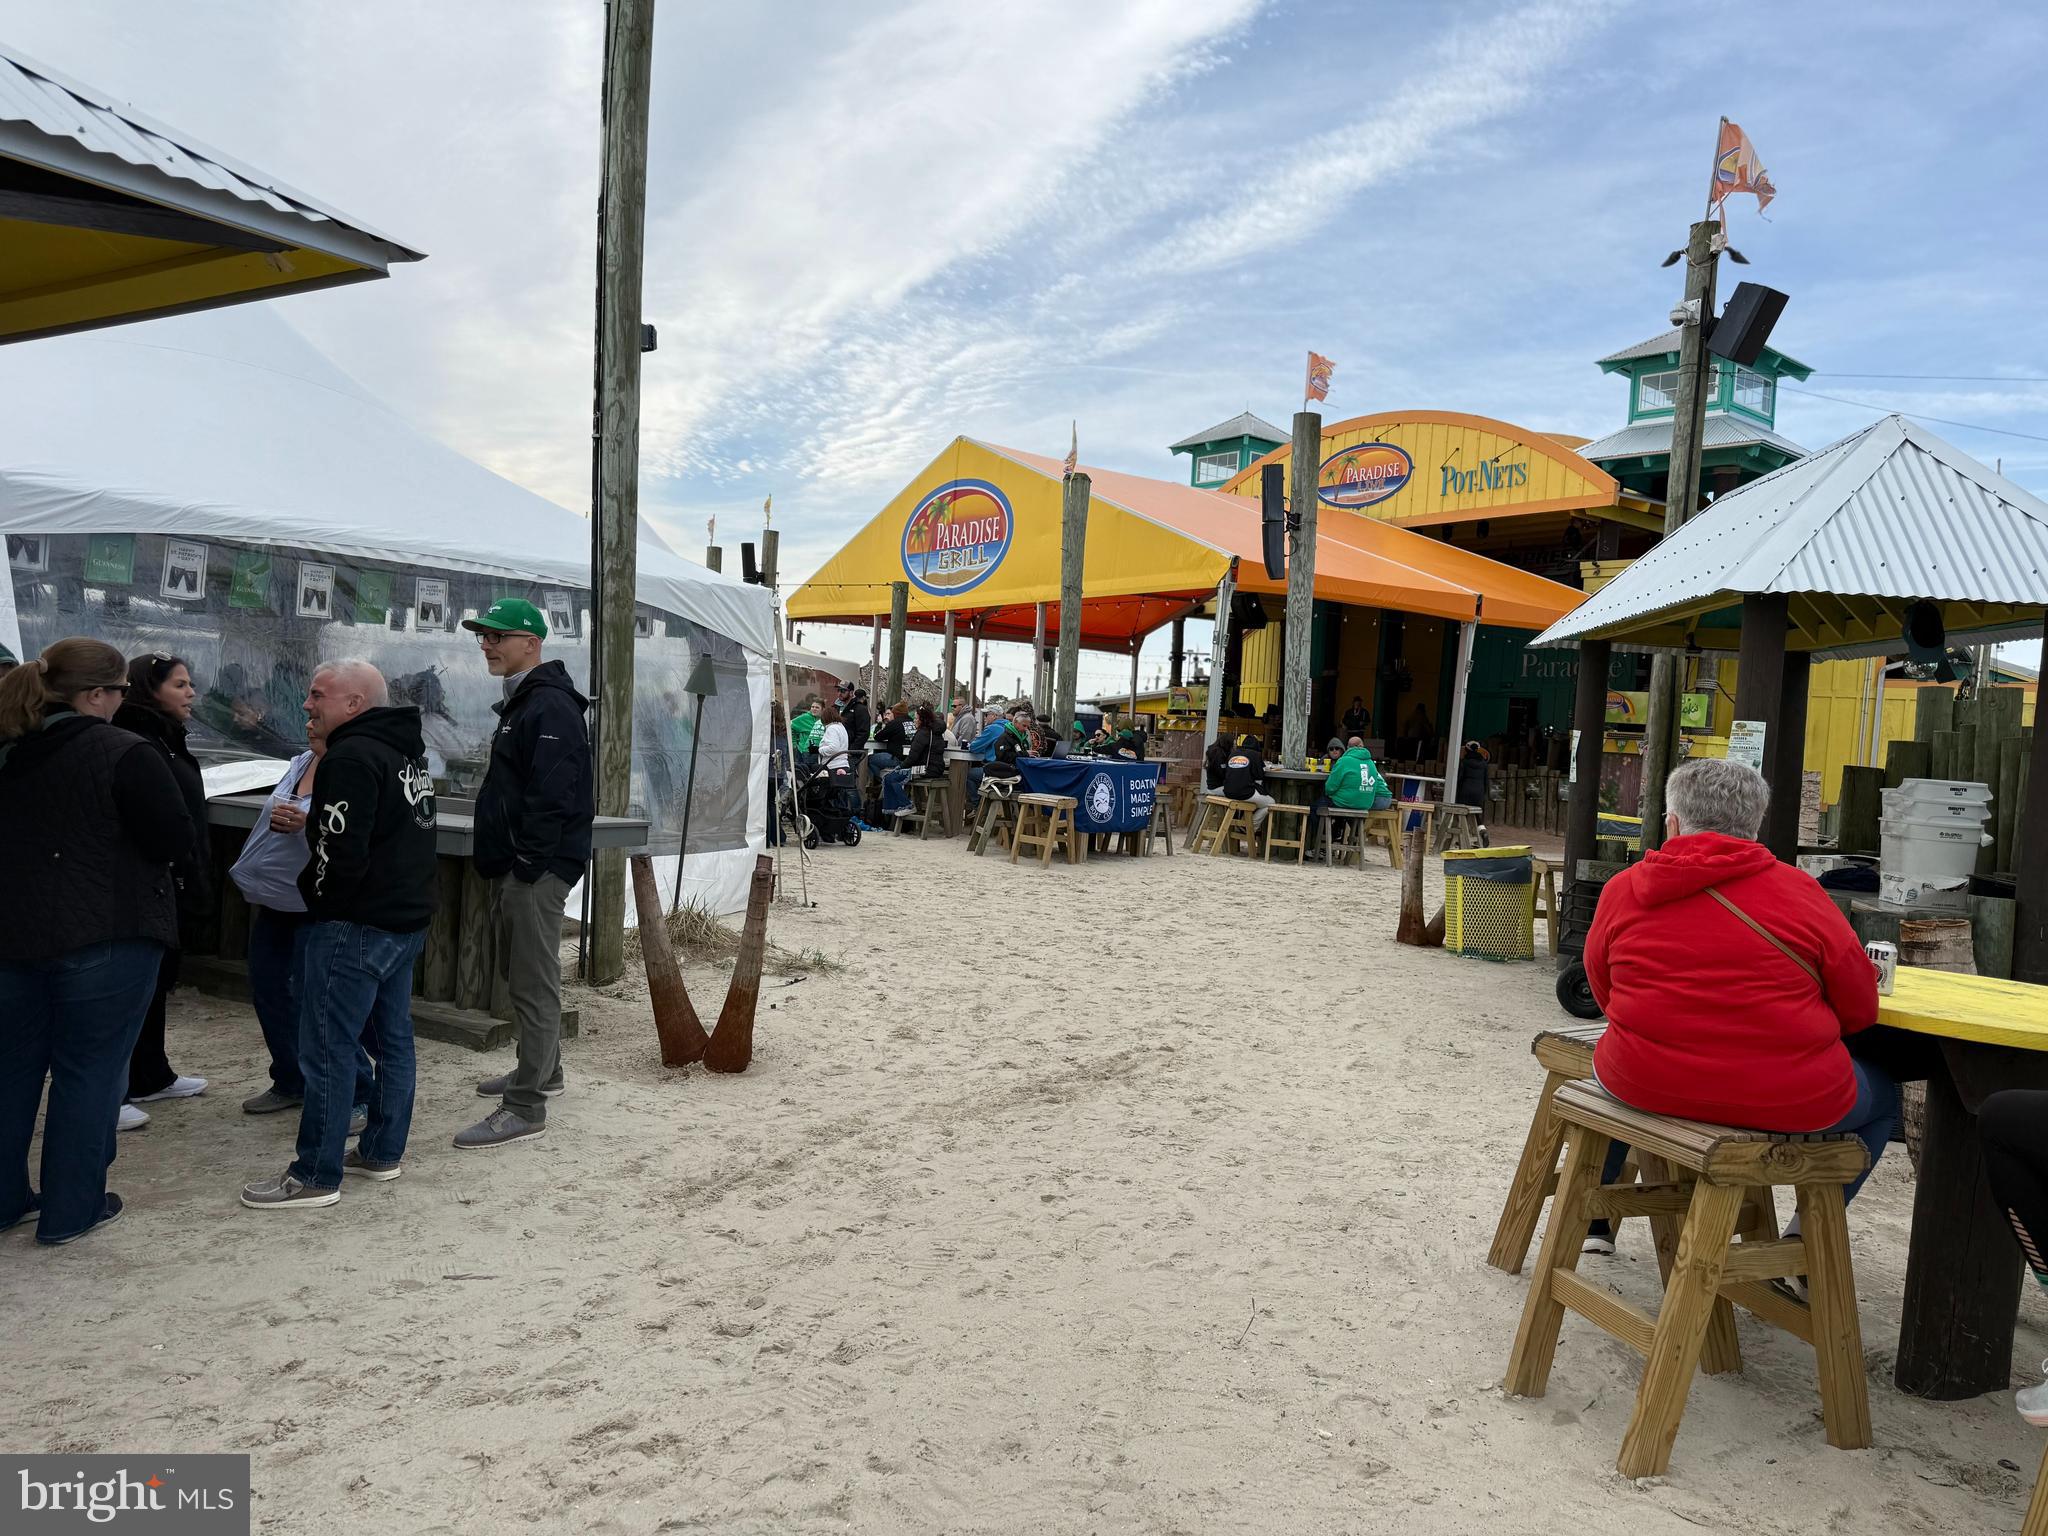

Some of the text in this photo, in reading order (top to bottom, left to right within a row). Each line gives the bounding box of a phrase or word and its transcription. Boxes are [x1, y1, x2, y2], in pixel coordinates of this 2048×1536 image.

[1345, 462, 1400, 485] PARADISE
[936, 516, 1000, 550] PARADISE
[92, 559, 126, 569] GUINNESS
[938, 545, 990, 570] GRILL
[1520, 653, 1624, 678] Parae
[1130, 779, 1156, 790] BOATIN
[1130, 793, 1150, 804] MADE
[1131, 805, 1153, 818] SIMPLE
